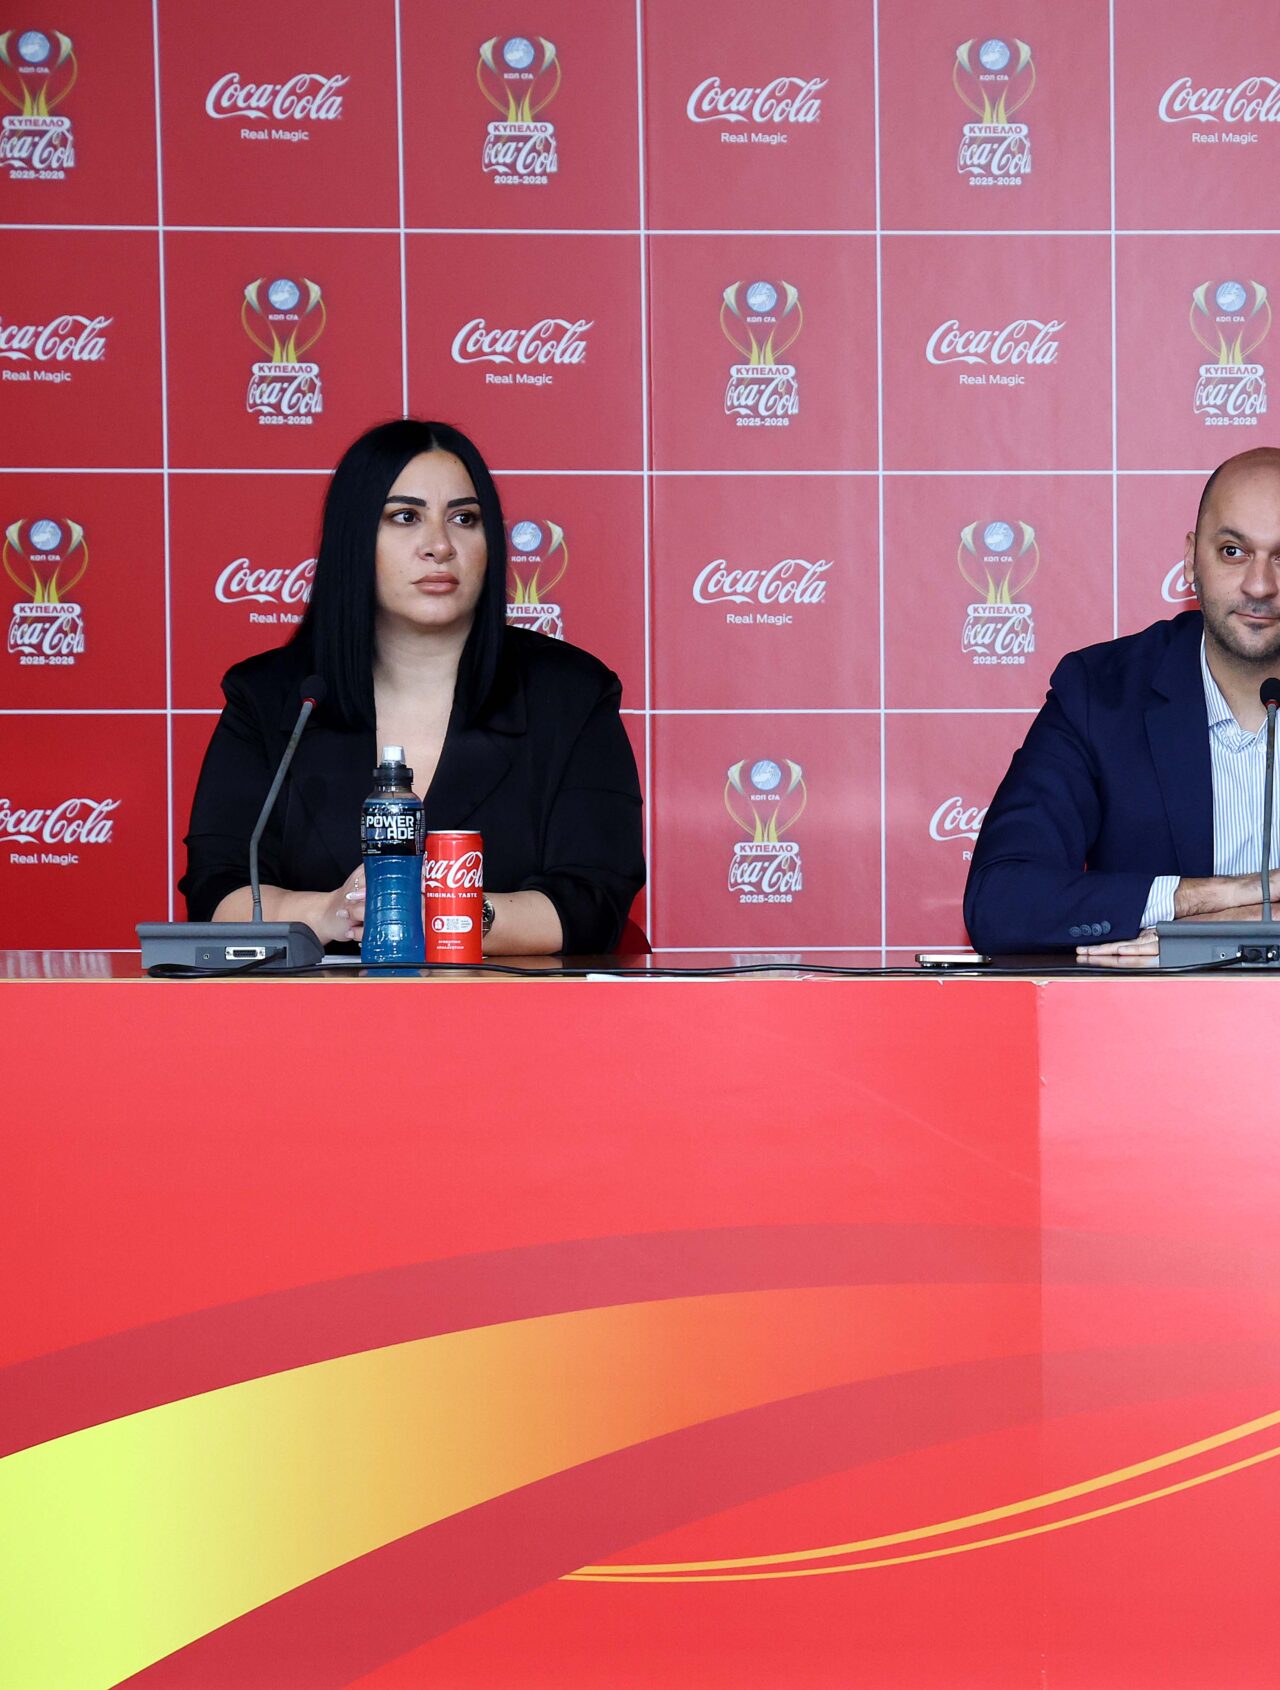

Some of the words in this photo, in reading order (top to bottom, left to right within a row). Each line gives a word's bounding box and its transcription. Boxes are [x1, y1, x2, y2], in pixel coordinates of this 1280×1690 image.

[205, 73, 350, 120] Coca-Cola
[687, 77, 829, 123] Coca-Cola
[240, 128, 268, 140] Real
[271, 128, 309, 142] Magic
[721, 132, 748, 143] Real
[751, 132, 788, 145] Magic
[1192, 132, 1218, 143] Real
[1222, 132, 1258, 145] Magic
[494, 176, 548, 185] 2025-2026
[969, 177, 1022, 186] 2025-2026
[0, 315, 114, 361] ca-Cola
[451, 318, 594, 364] Coca-Cola
[926, 320, 1066, 365] Coca-Cola
[2, 370, 30, 381] Real
[33, 370, 71, 383] Magic
[486, 373, 513, 384] Real
[516, 373, 553, 386] Magic
[959, 374, 985, 385] Real
[989, 374, 1025, 387] Magic
[259, 416, 313, 425] 2025-2026
[736, 418, 789, 426] 2025-2026
[1205, 418, 1257, 426] 2025-2026
[215, 557, 318, 604] Coca-C
[693, 559, 834, 604] Coca-Cola
[508, 606, 554, 615] ΥΠΕΛΛΟ
[249, 613, 277, 623] Real
[726, 613, 753, 624] Real
[756, 613, 793, 626] Magic
[20, 657, 75, 665] 2025-2026
[366, 815, 414, 827] POWER
[387, 828, 414, 839] ADE
[10, 853, 38, 864] Real
[41, 853, 79, 866] Magic
[740, 895, 793, 903] 2025-2026
